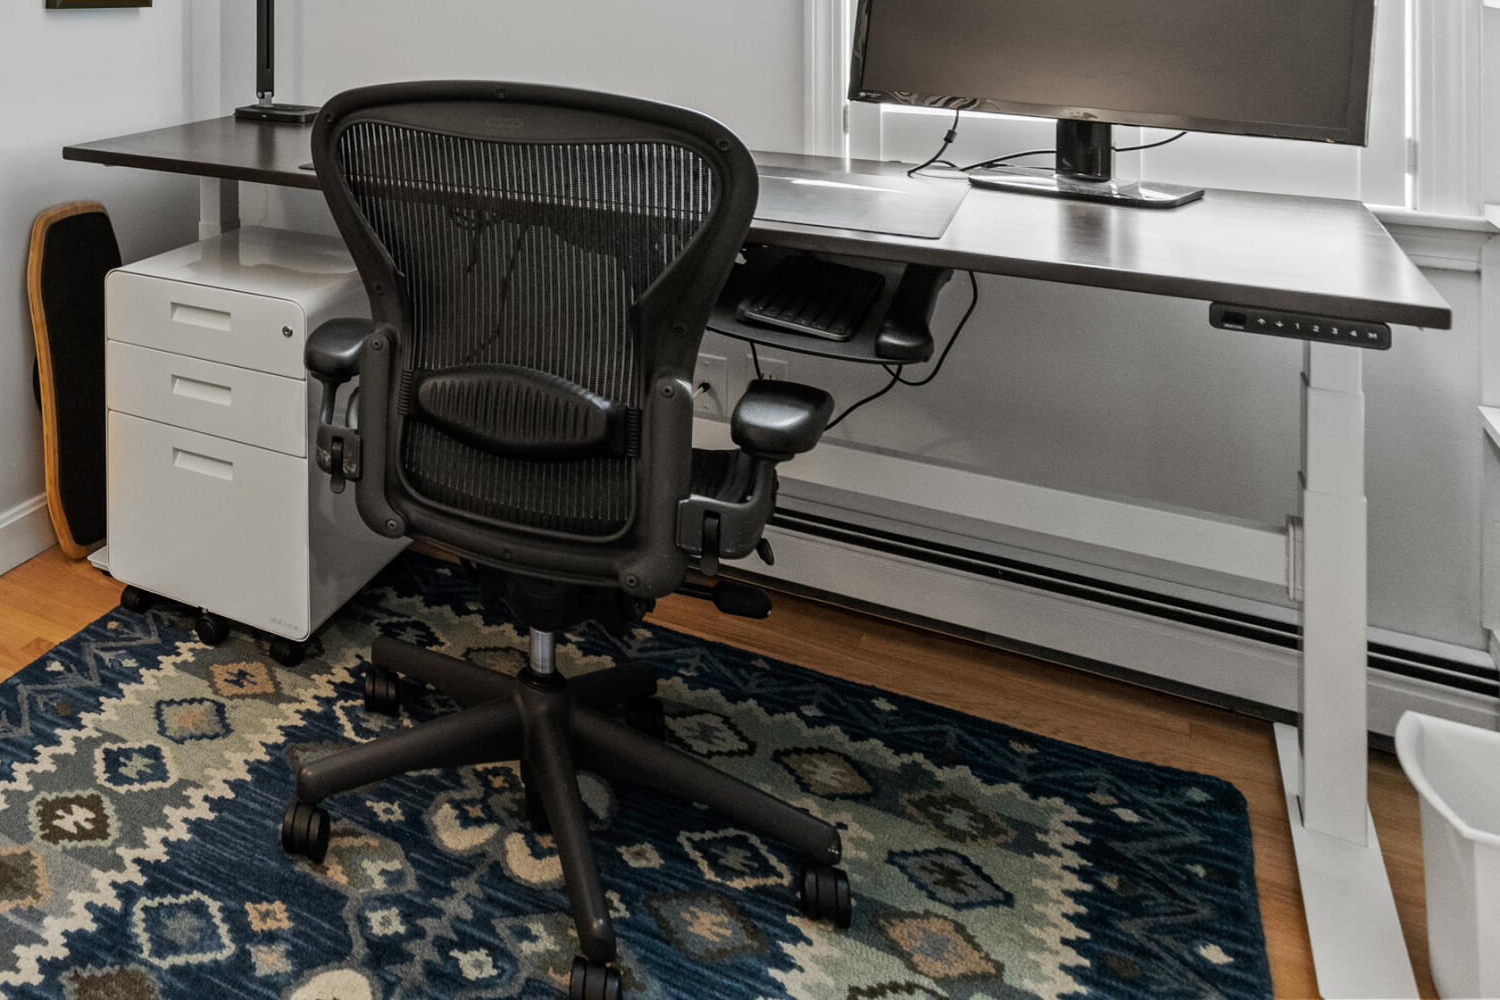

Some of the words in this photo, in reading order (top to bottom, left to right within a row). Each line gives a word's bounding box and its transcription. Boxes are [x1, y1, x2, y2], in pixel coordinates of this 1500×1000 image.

[1312, 325, 1319, 333] 2
[1331, 327, 1338, 335] 3
[1368, 332, 1378, 340] M
